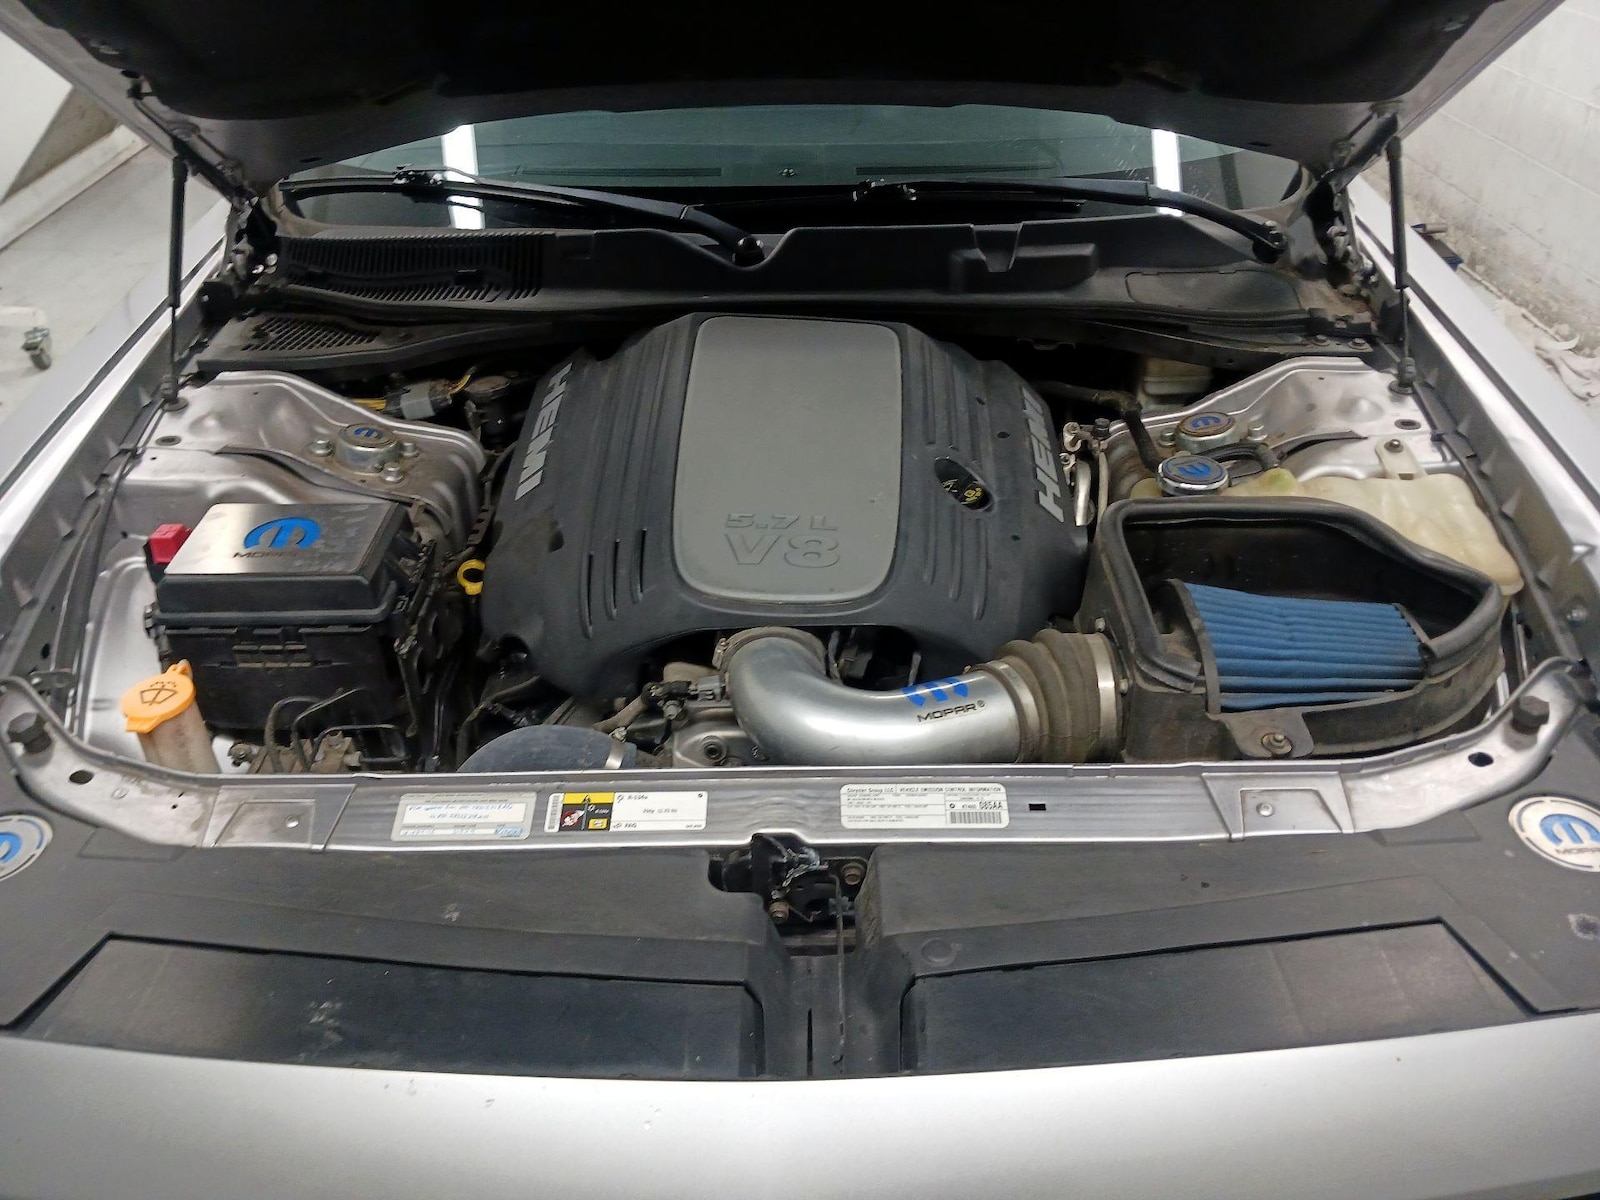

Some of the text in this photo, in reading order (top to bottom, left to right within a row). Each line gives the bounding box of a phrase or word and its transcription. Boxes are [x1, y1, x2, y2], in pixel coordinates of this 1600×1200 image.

[514, 361, 573, 501] HEMI
[1021, 386, 1065, 523] HEMI
[724, 534, 841, 569] V8
